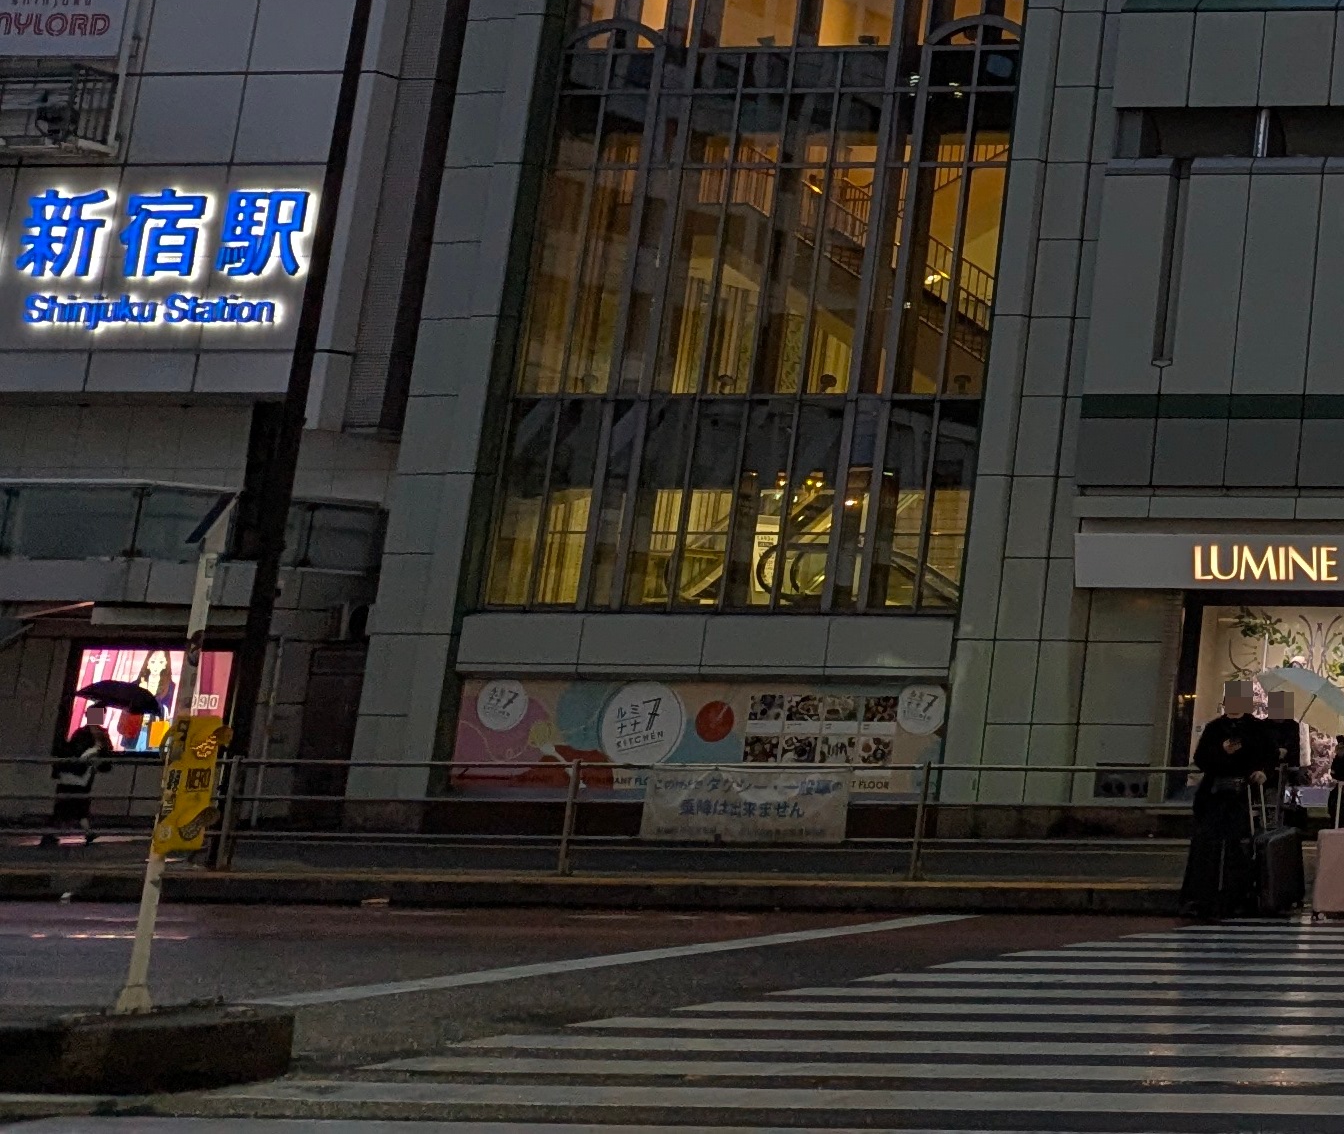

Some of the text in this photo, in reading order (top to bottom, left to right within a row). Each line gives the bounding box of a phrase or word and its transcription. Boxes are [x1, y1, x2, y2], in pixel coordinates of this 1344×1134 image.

[15, 188, 313, 278] 新宿駅
[24, 292, 276, 331] Shinjuku Station
[1194, 545, 1338, 582] LUMINE
[858, 780, 889, 790] FLOOR
